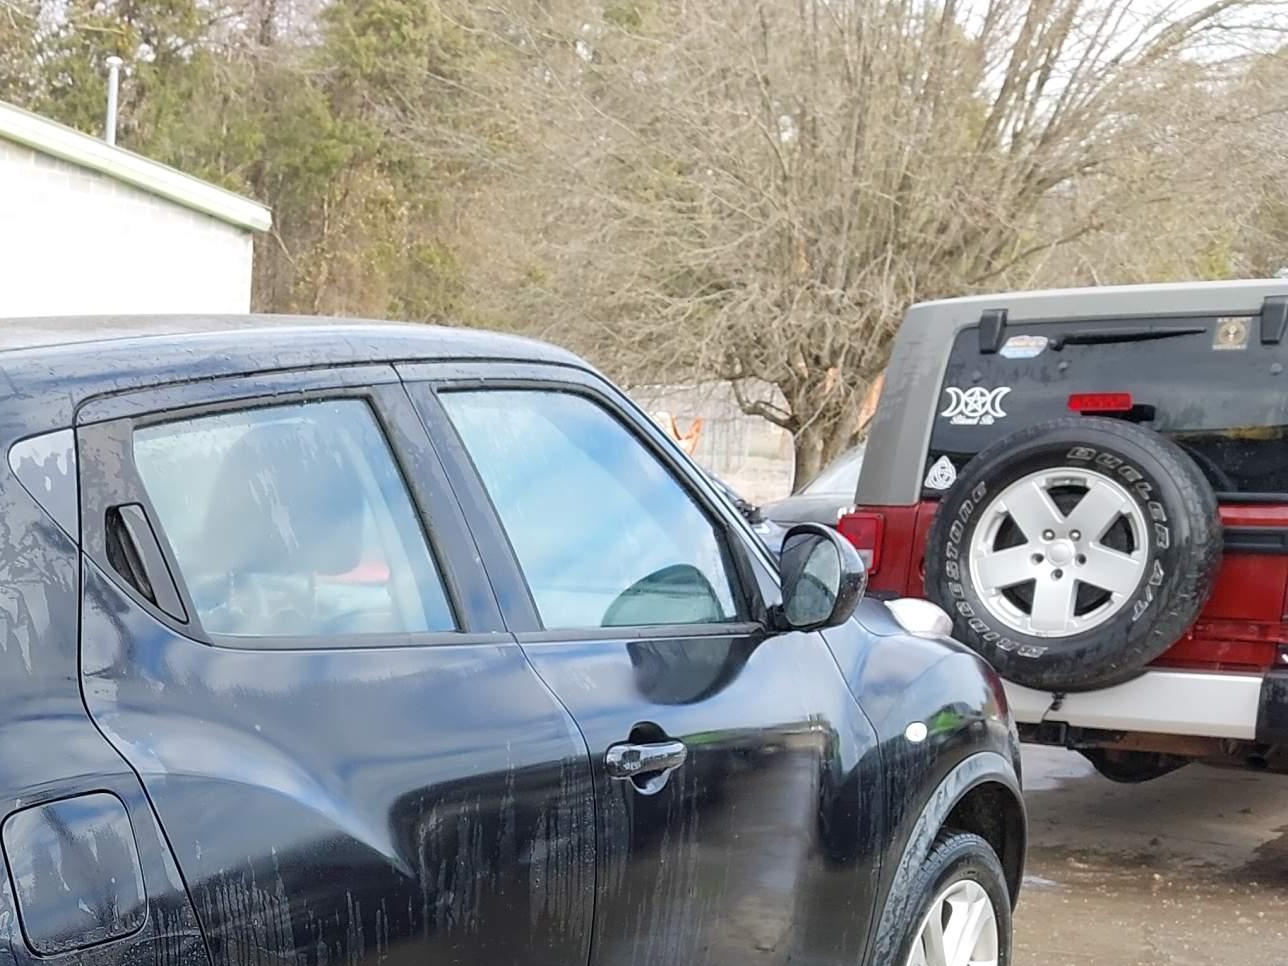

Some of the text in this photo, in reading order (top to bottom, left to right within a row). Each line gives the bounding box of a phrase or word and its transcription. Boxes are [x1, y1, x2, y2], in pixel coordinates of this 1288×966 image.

[945, 480, 1050, 659] BRIDGESTONE
[1066, 445, 1170, 622] DUELER A/T
